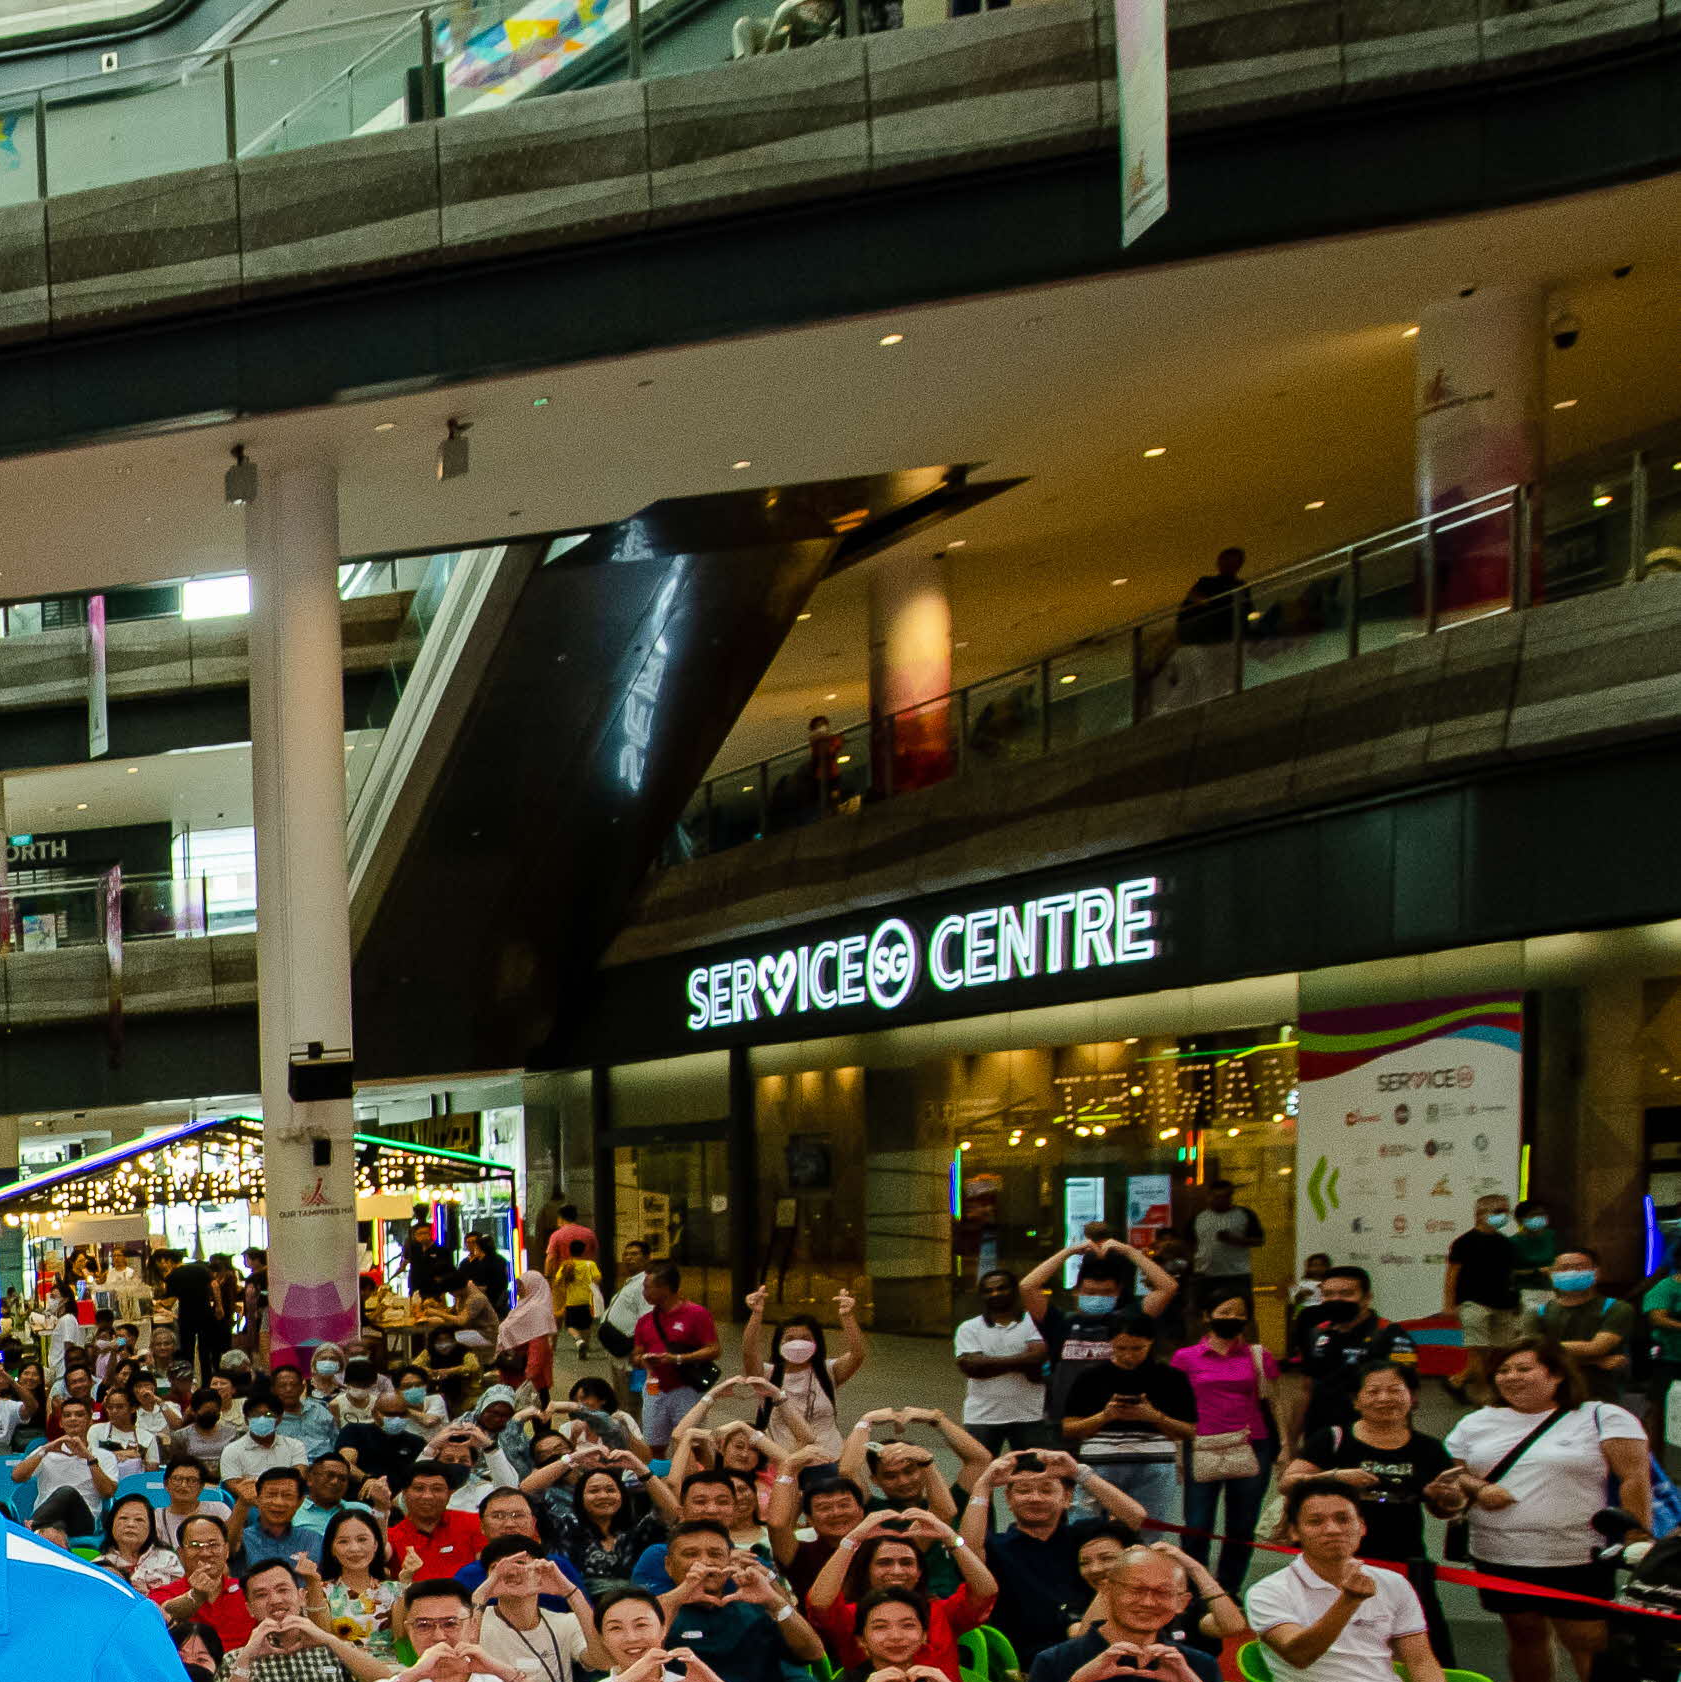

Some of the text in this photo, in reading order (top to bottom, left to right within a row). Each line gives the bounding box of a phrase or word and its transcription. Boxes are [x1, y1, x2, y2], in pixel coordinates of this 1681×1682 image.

[5, 838, 68, 863] ORTH
[687, 936, 868, 1031] SERVICE
[929, 877, 1157, 991] CENTRE
[278, 1210, 297, 1219] OUR
[297, 1208, 340, 1217] TAMPINES
